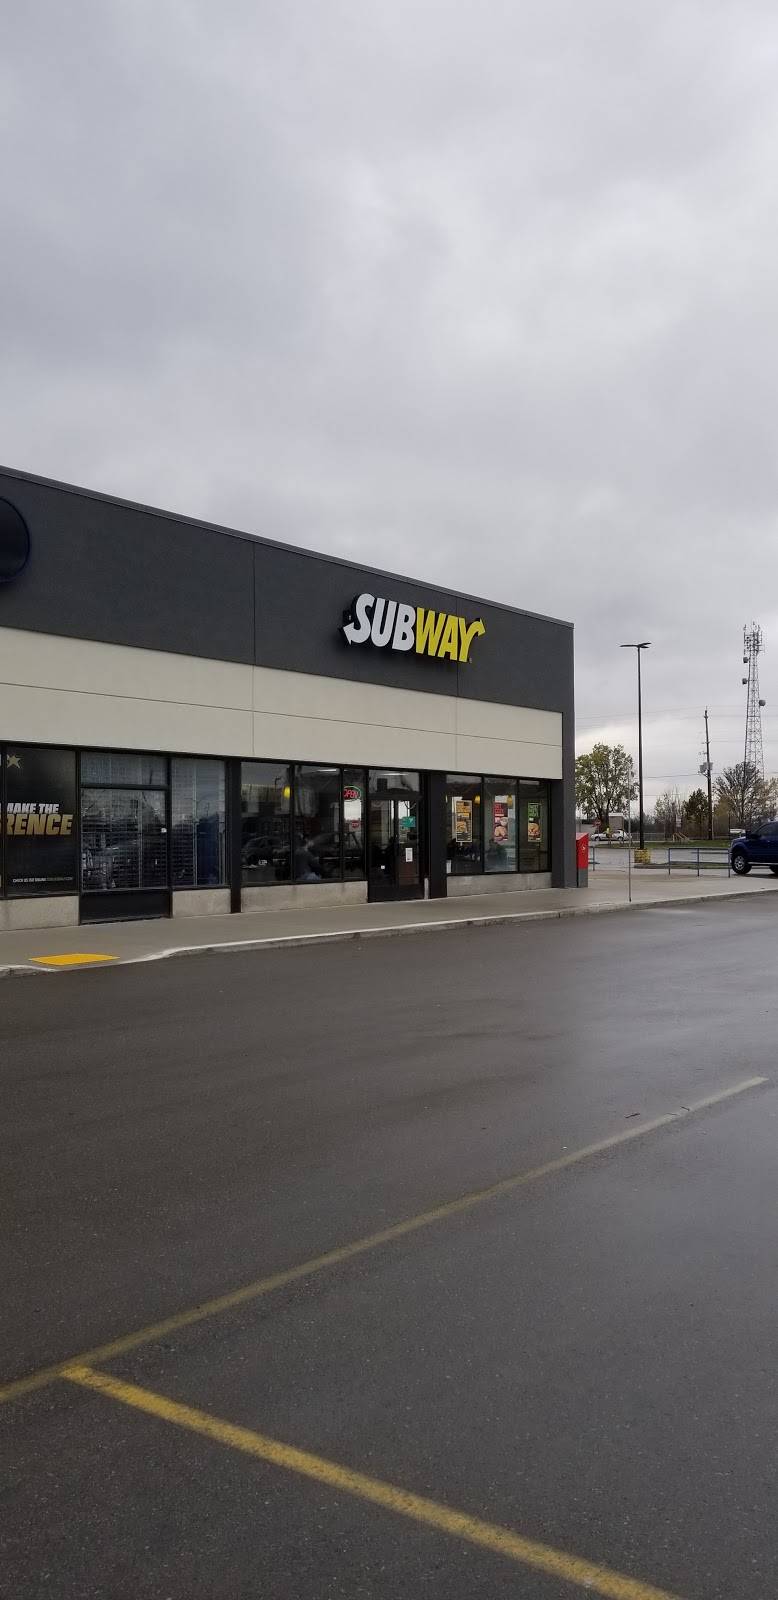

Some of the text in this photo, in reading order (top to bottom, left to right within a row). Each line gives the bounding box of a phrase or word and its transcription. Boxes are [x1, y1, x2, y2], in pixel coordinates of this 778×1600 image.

[343, 593, 485, 663] SUBWAY
[344, 788, 359, 799] OPEN
[39, 804, 60, 814] THE
